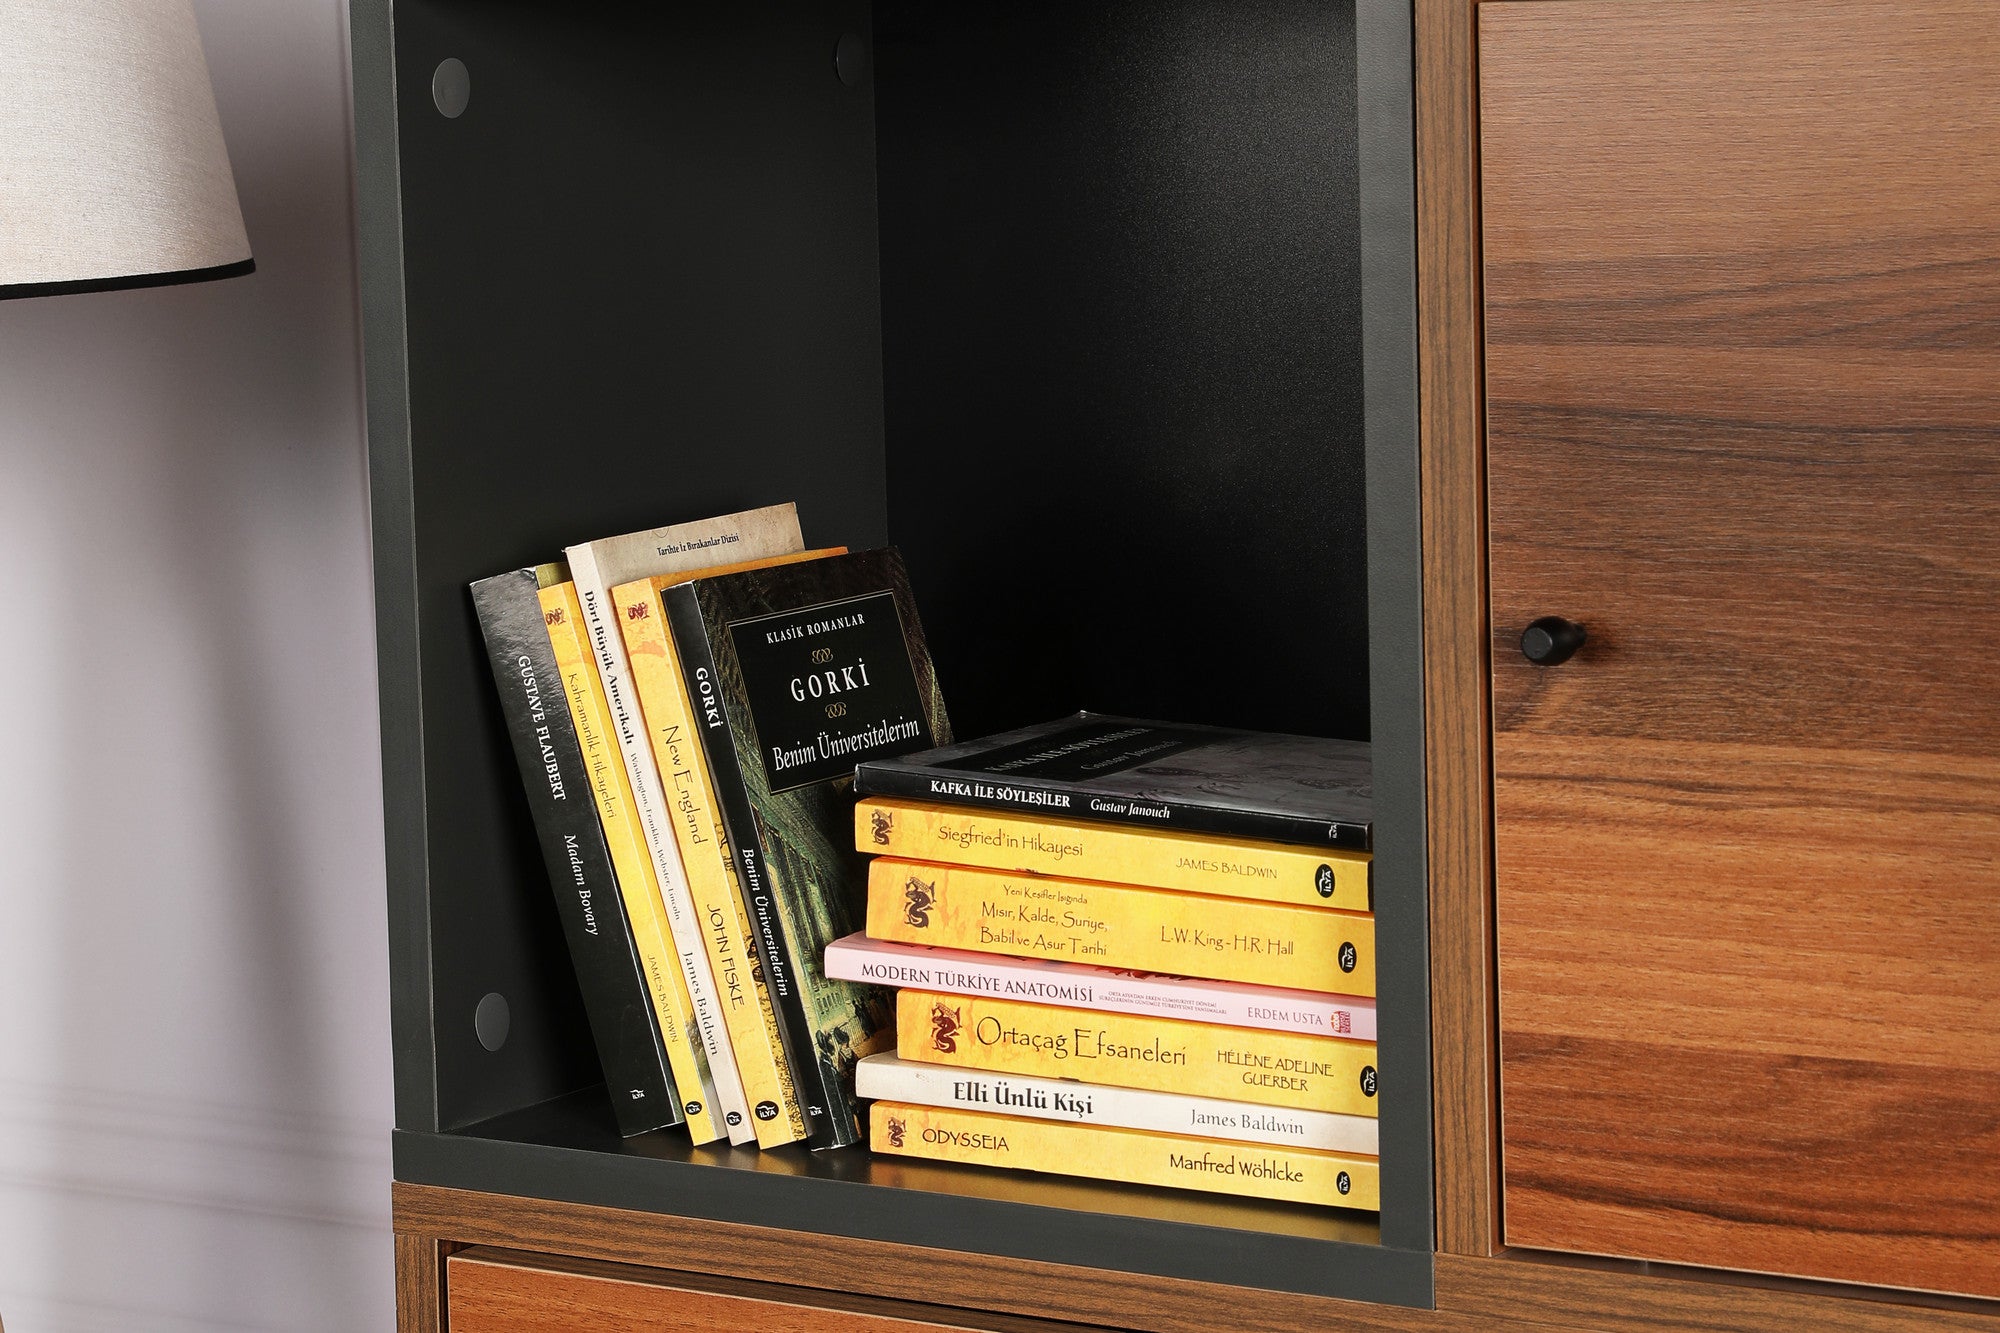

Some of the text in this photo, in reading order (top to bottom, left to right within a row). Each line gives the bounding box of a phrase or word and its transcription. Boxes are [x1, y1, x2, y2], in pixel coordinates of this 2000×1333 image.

[657, 533, 740, 556] Tarihte İz Bırakanlar Dizisi
[766, 613, 866, 644] KLASİK ROMANLAR
[584, 590, 635, 745] Dört Büyük Amerikalı
[790, 657, 871, 702] GORKİ
[695, 667, 724, 729] GORKİ
[518, 655, 567, 801] GUSTAVE FLAUBERT
[772, 715, 921, 771] Benim Üniversitelerim
[568, 673, 617, 819] Kahramanlık Hikayeleri
[662, 725, 709, 845] New England
[930, 780, 1071, 808] KAFKA İLE SÖYLEŞİLER
[1090, 798, 1171, 819] Gustav Janouch
[630, 752, 681, 920] Washington, Franklin, Webster, Lincoln
[1022, 833, 1084, 861] Hikayesi
[564, 834, 599, 936] Madam Bovary
[1176, 857, 1278, 879] JAMES BALDWIN
[1003, 884, 1023, 896] Yeni
[742, 848, 788, 997] Benim Üniversitelerim
[982, 901, 1108, 934] Mısır, Kalde, Suriye,
[706, 904, 745, 1010] JOHN FISKE
[980, 926, 1108, 956] Babil ve Asur Tarihi
[1194, 929, 1224, 951] King
[1233, 935, 1264, 953] H.R.
[1267, 938, 1294, 956] Hall
[647, 954, 679, 1043] JAMES BALDWIN
[861, 963, 1093, 1002] MODERN TÜRKİYE ANATOMİSİ
[682, 952, 719, 1056] James Baldwin
[1247, 1006, 1289, 1022] ERDEM
[1293, 1012, 1323, 1026] USTA
[976, 1016, 1186, 1066] Ortaçağ Efsaneleri
[1242, 1071, 1309, 1092] GUERBER
[1275, 1058, 1335, 1077] ADELINE
[953, 1081, 1094, 1118] Elli Ünlü Kişi
[1190, 1109, 1304, 1135] James Baldwin
[922, 1128, 1010, 1152] ODYSSEIA
[1170, 1152, 1304, 1183] Manfred Wöhlcke
